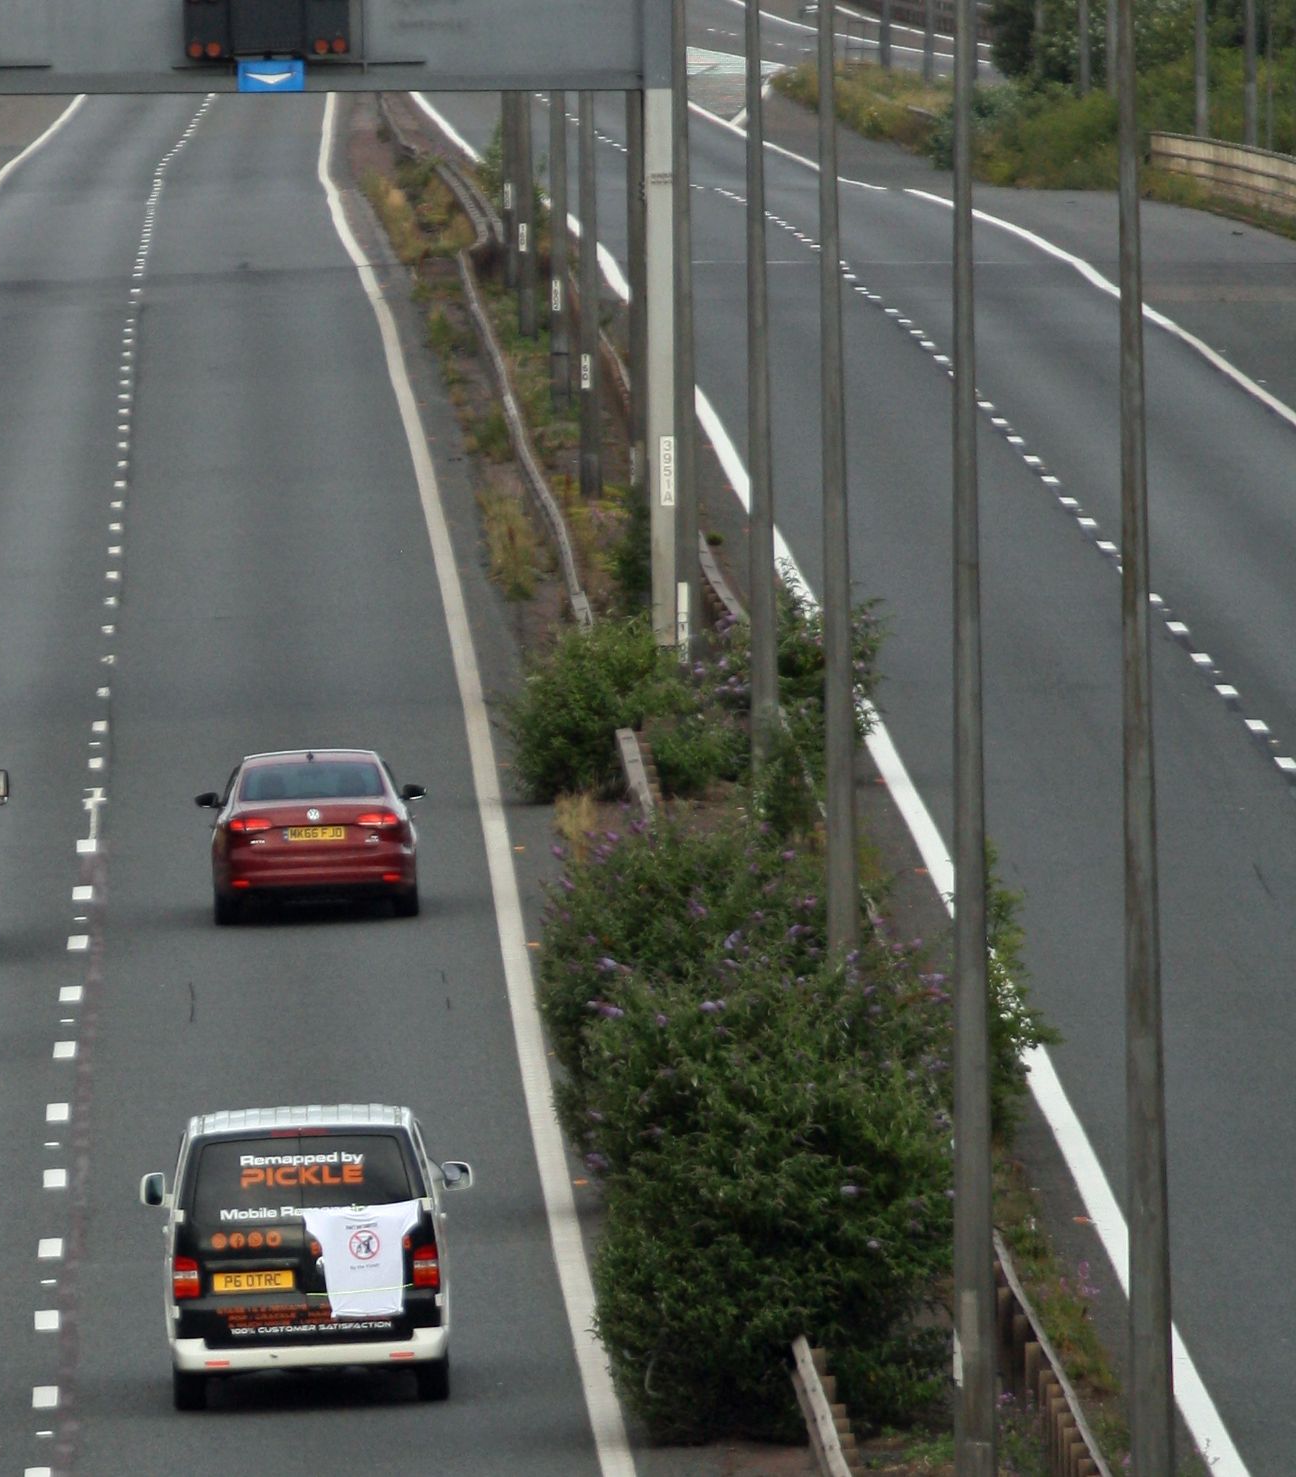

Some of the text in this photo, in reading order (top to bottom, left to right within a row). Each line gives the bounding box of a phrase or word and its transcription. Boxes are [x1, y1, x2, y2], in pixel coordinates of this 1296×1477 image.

[663, 440, 672, 503] 3951A
[289, 827, 319, 839] MK66
[240, 1151, 364, 1166] Remapped by
[240, 1164, 364, 1189] PICKLE
[220, 1206, 277, 1221] Mobile
[231, 1326, 255, 1335] 100%
[257, 1324, 316, 1334] CUSTOMER
[318, 1320, 392, 1331] SATISFACTION
